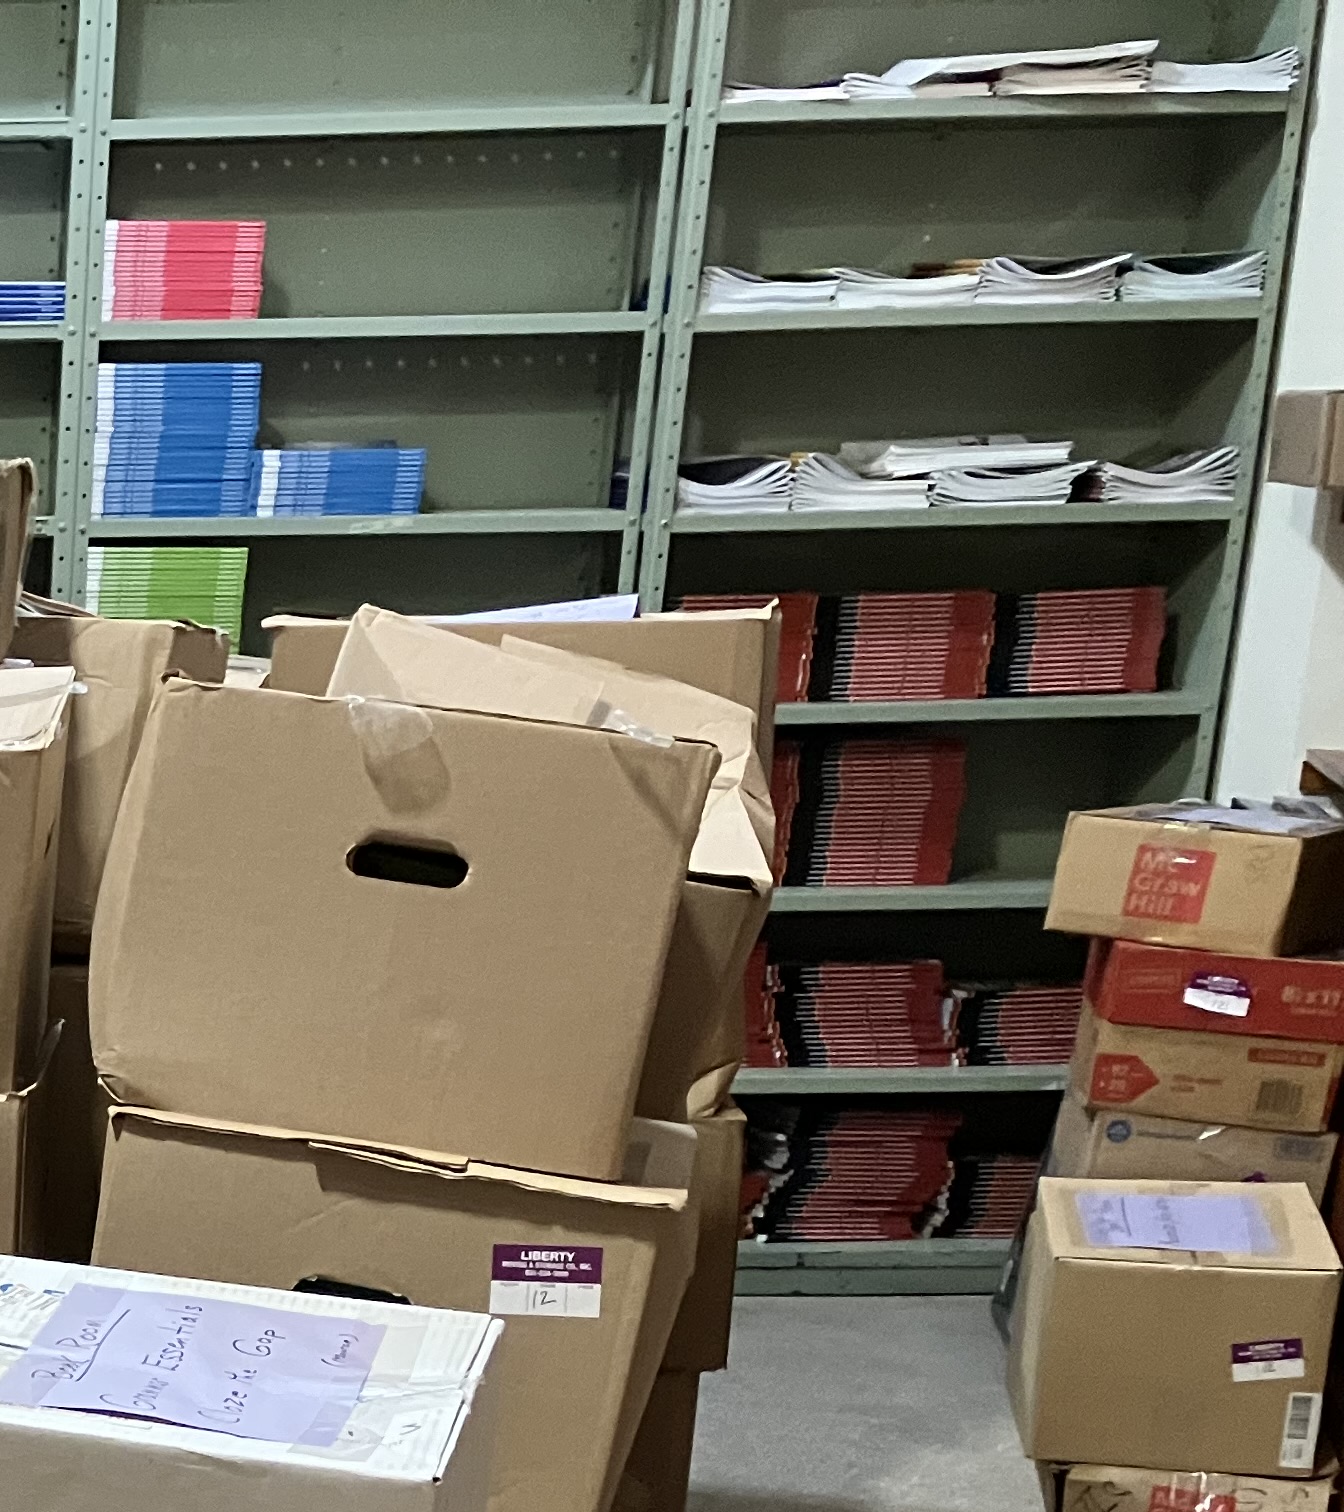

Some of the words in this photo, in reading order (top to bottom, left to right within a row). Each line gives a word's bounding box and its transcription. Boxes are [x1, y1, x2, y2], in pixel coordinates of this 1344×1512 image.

[520, 1251, 576, 1262] LIBERTY
[532, 1290, 557, 1309] 12
[142, 1303, 204, 1373] Essentials
[231, 1328, 286, 1358] Gap
